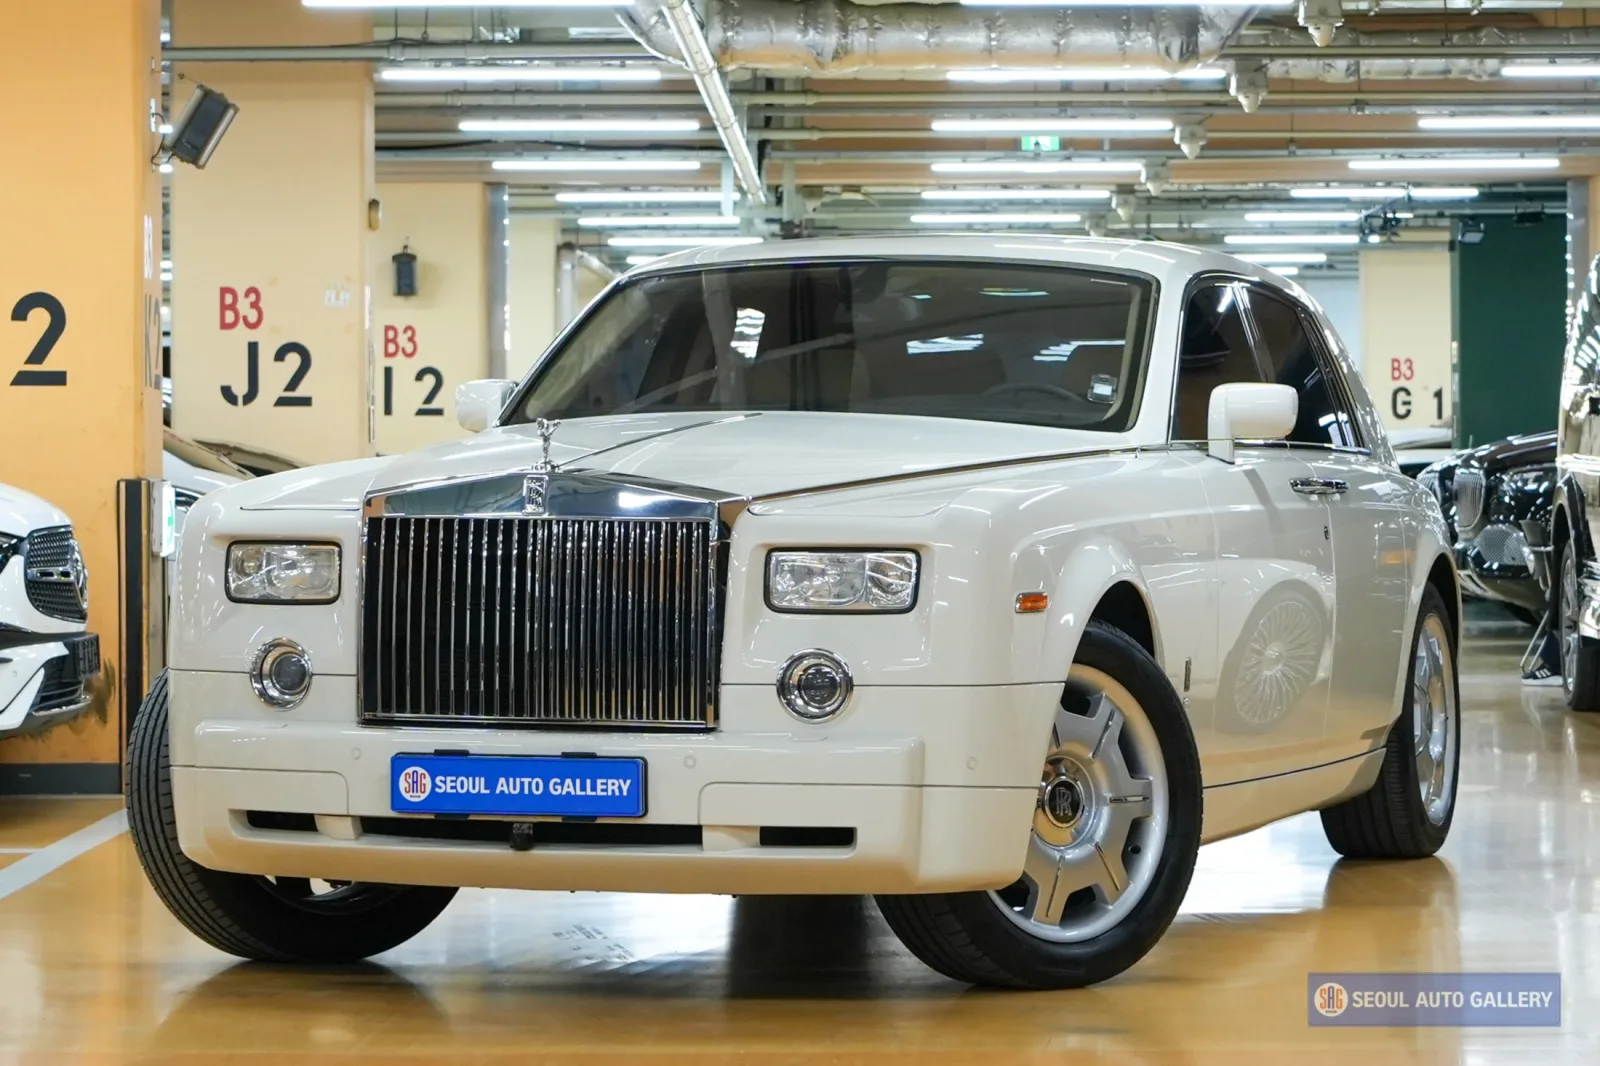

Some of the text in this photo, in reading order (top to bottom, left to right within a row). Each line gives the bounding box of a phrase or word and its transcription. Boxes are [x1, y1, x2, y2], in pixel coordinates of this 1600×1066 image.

[219, 286, 264, 330] B3
[9, 291, 67, 386] 2
[383, 324, 418, 358] B3
[1391, 358, 1414, 381] B3
[404, 769, 427, 794] SAG
[434, 775, 631, 796] SEOUL AUTO GALLERY
